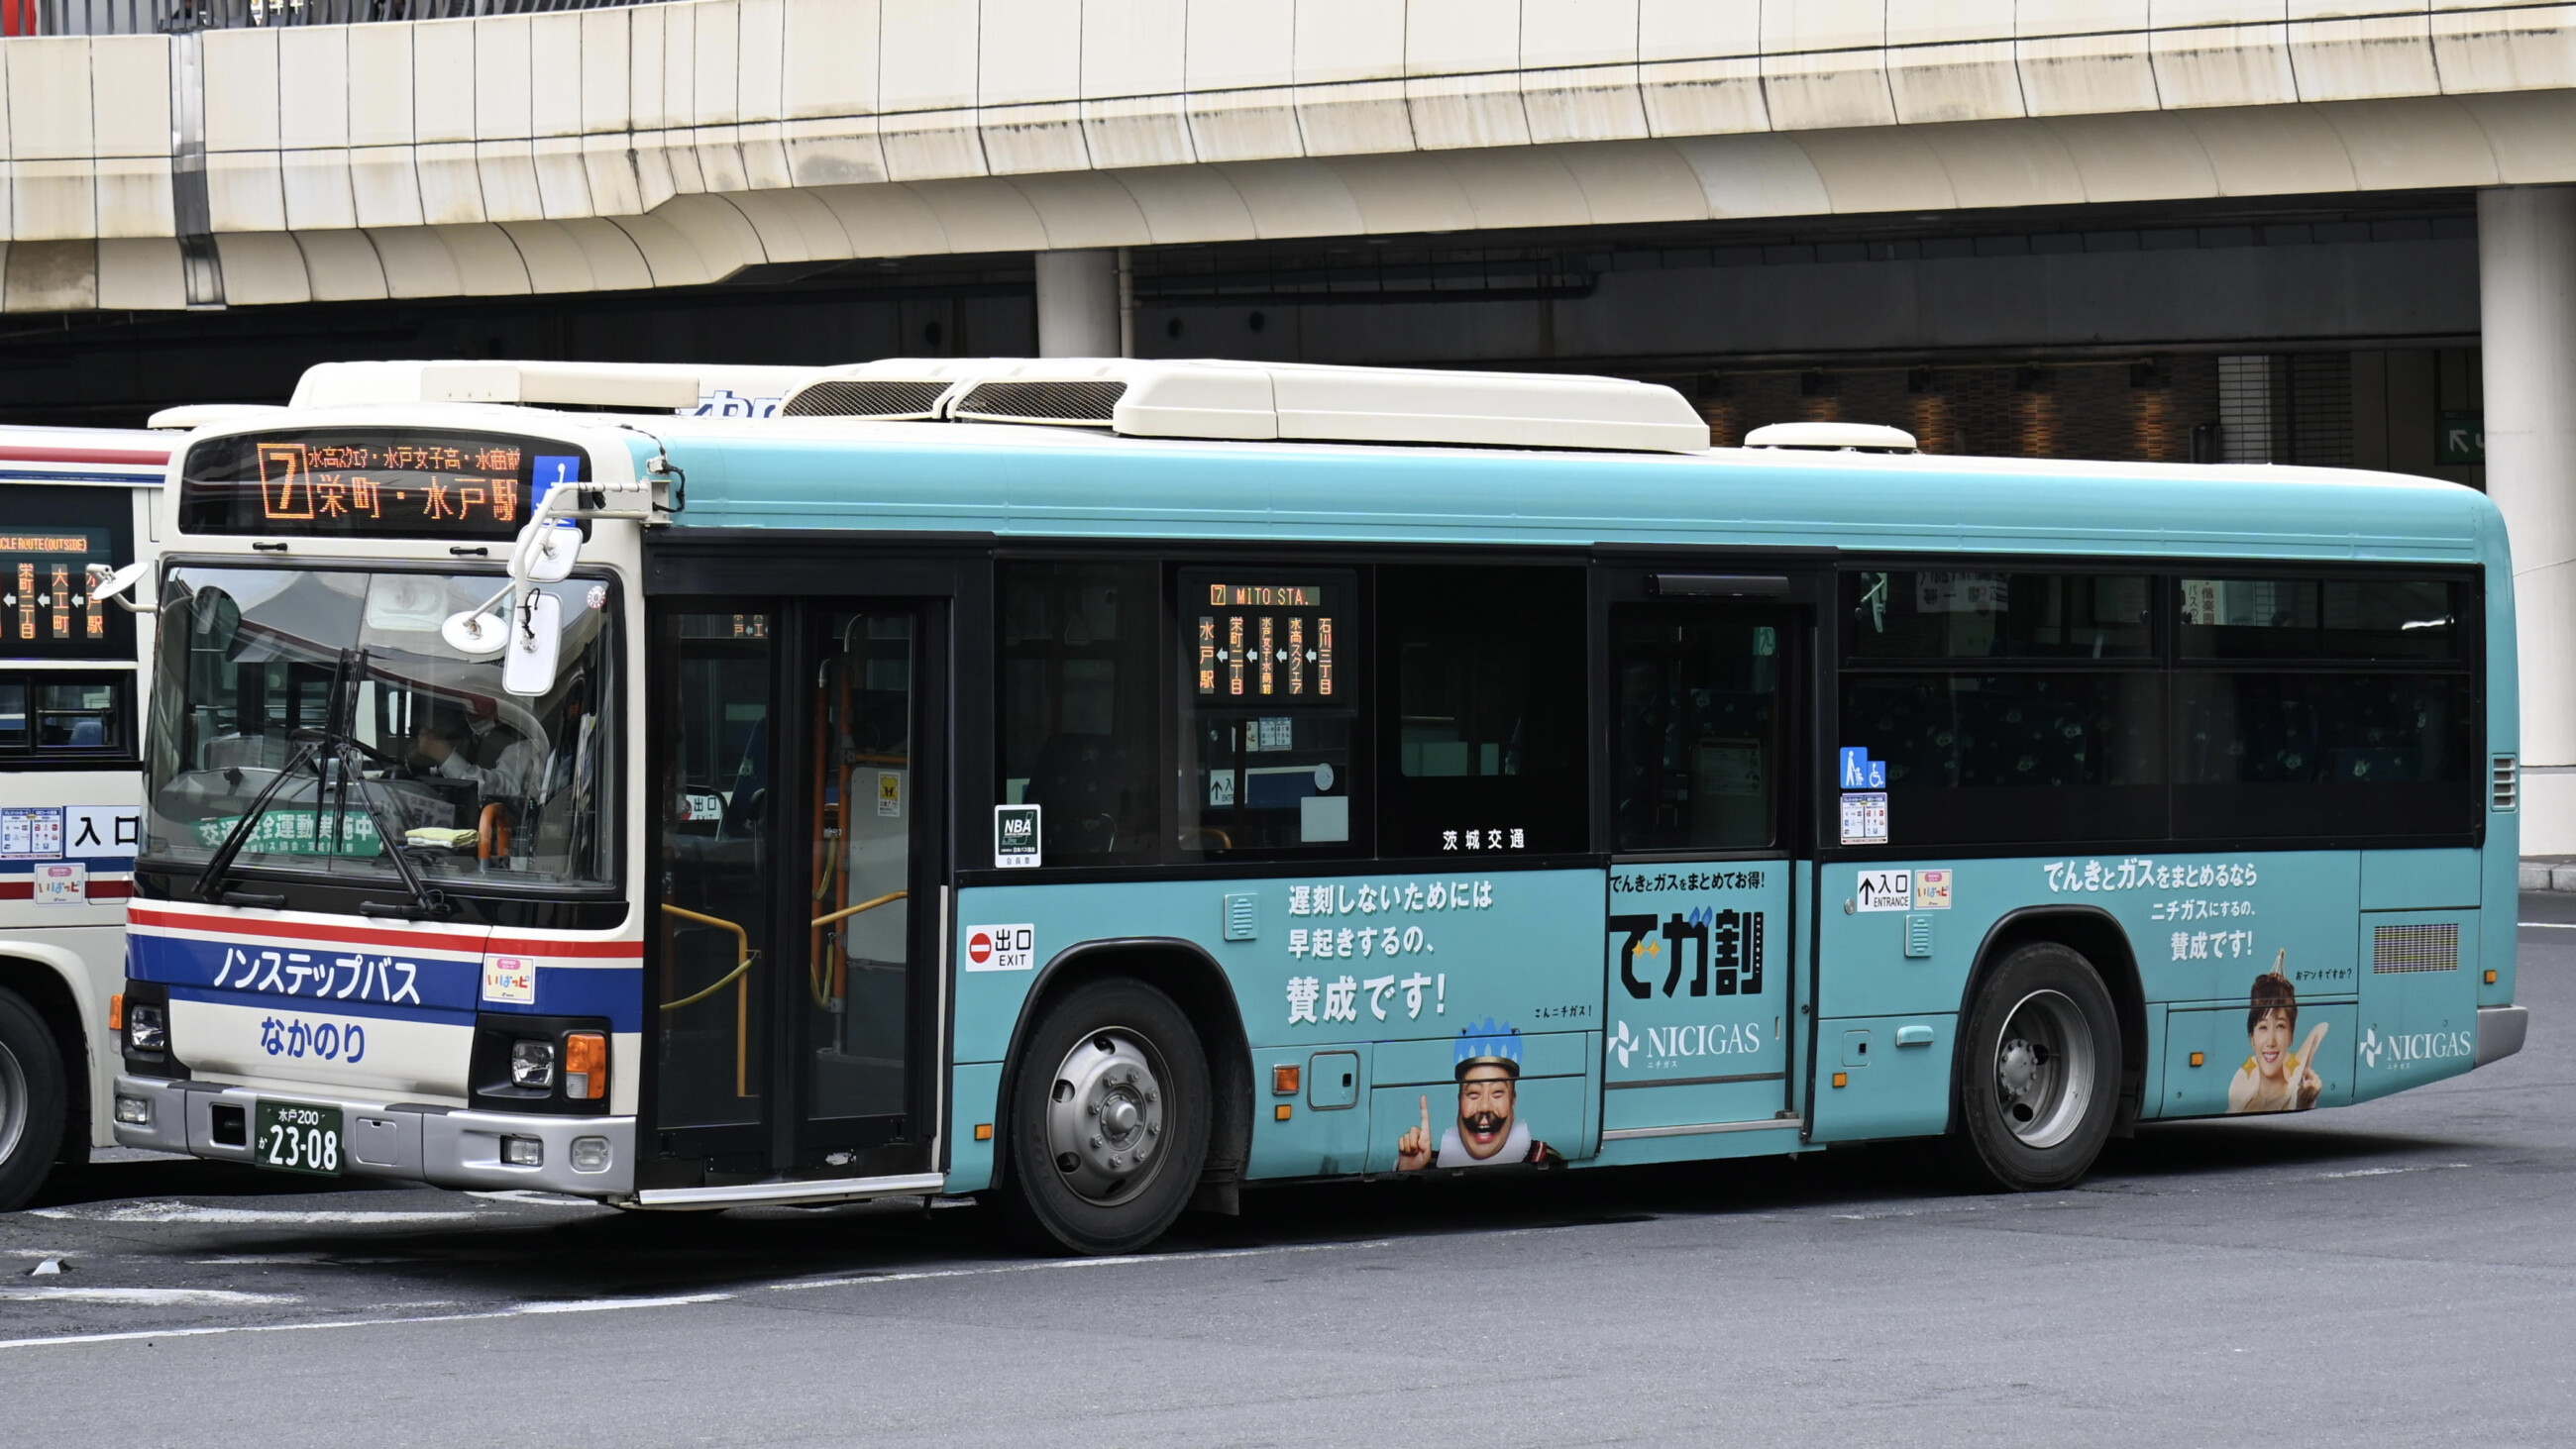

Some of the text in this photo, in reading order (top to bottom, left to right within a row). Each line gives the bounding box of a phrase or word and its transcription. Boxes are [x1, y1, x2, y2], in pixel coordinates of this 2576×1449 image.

[269, 452, 296, 510] 7
[316, 473, 519, 522] 栄町・水戸駅
[0, 538, 17, 551] CLE
[19, 564, 36, 640] 栄町二丁目
[53, 568, 69, 634] 大工町
[1236, 587, 1270, 605] MITO
[1277, 588, 1309, 605] STA.
[1199, 620, 1215, 689] 水戸駅
[1230, 616, 1243, 695] 栄町二丁目
[1290, 618, 1303, 694] 水高スクエア
[1319, 618, 1333, 695] 石川三丁目
[74, 815, 140, 847] 入口
[1004, 818, 1031, 833] NBA
[1443, 827, 1526, 851] 茨城交通
[1609, 871, 1766, 893] でんきとガスをまとめてお得!
[1878, 874, 1908, 894] 入口
[2044, 858, 2258, 892] でんきとガスをまとめるなら
[1288, 880, 1493, 917] 遅刻しないためには
[1874, 896, 1909, 907] ENTRANCE
[2151, 898, 2257, 922] ニチガスにするの、
[995, 929, 1032, 953] 出口
[1288, 926, 1436, 961] 早起きするの、
[2170, 929, 2253, 963] 賛成です!
[213, 947, 421, 1005] ノンステップバス
[998, 953, 1026, 967] EXIT
[1286, 972, 1446, 1028] 賛成です!
[261, 1016, 366, 1064] なかのり
[1647, 1022, 1761, 1059] NICIGAS
[2388, 1031, 2472, 1062] NICIGAS
[1647, 1060, 1677, 1070] ニチガス
[268, 1125, 338, 1172] 23-08
